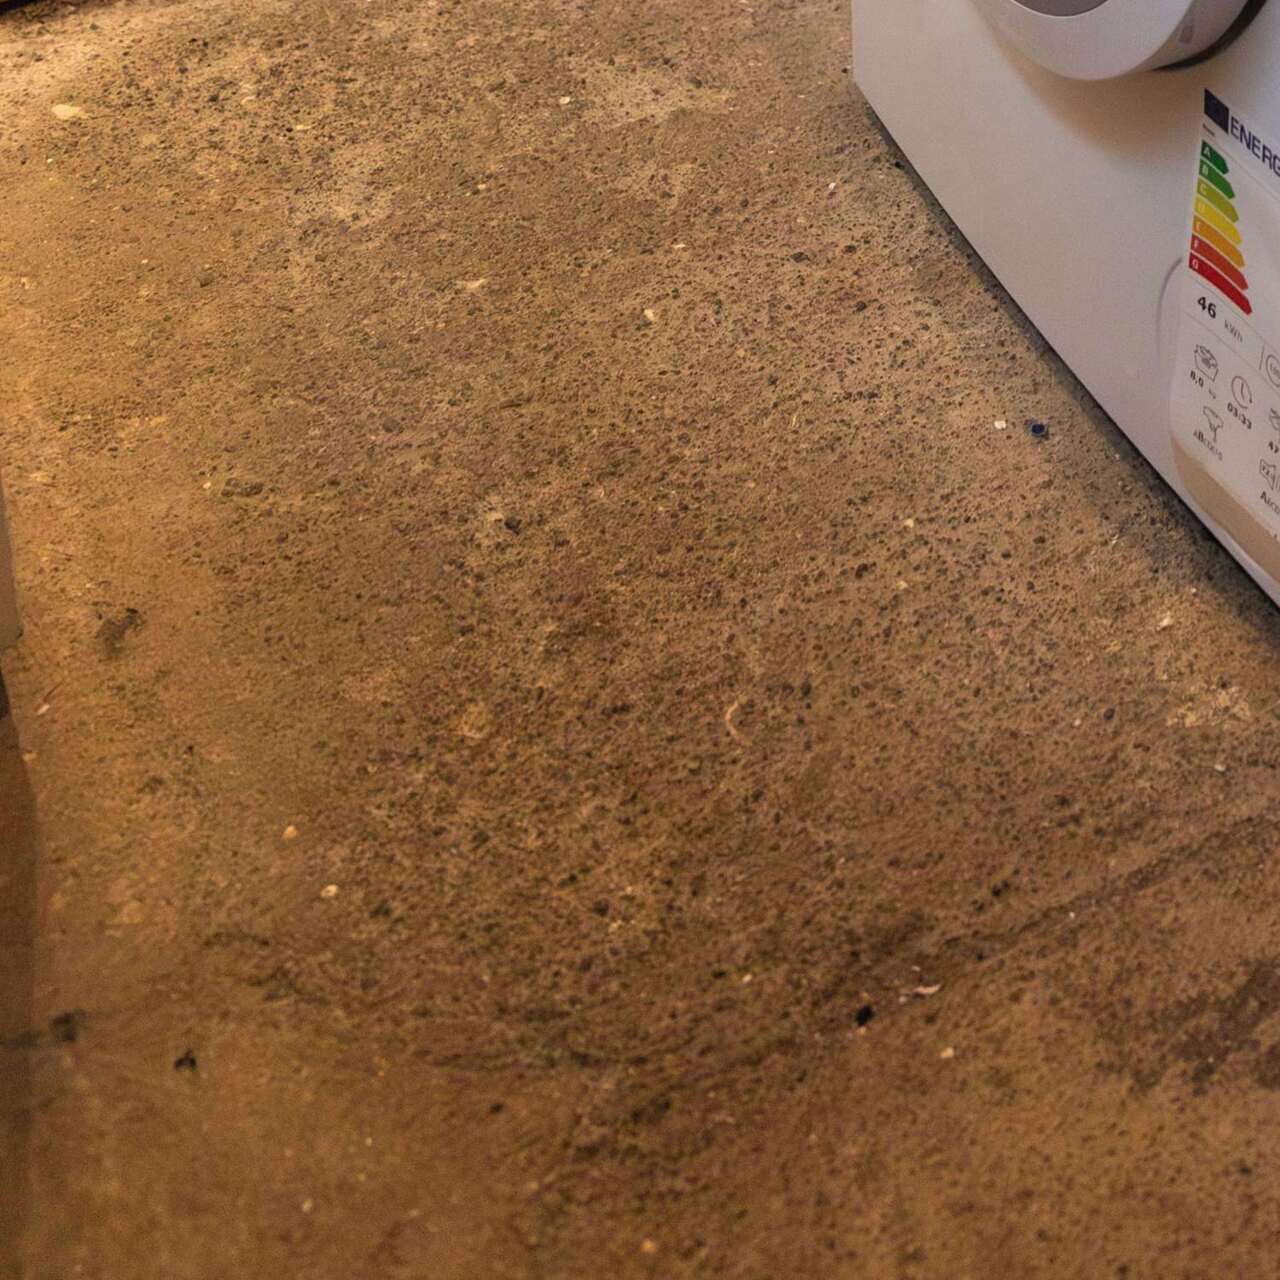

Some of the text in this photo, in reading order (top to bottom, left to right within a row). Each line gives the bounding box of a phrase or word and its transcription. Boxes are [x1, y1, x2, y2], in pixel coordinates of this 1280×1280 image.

[1202, 145, 1211, 158] A
[1201, 163, 1209, 177] B
[1191, 256, 1199, 271] G
[1197, 296, 1217, 319] 46
